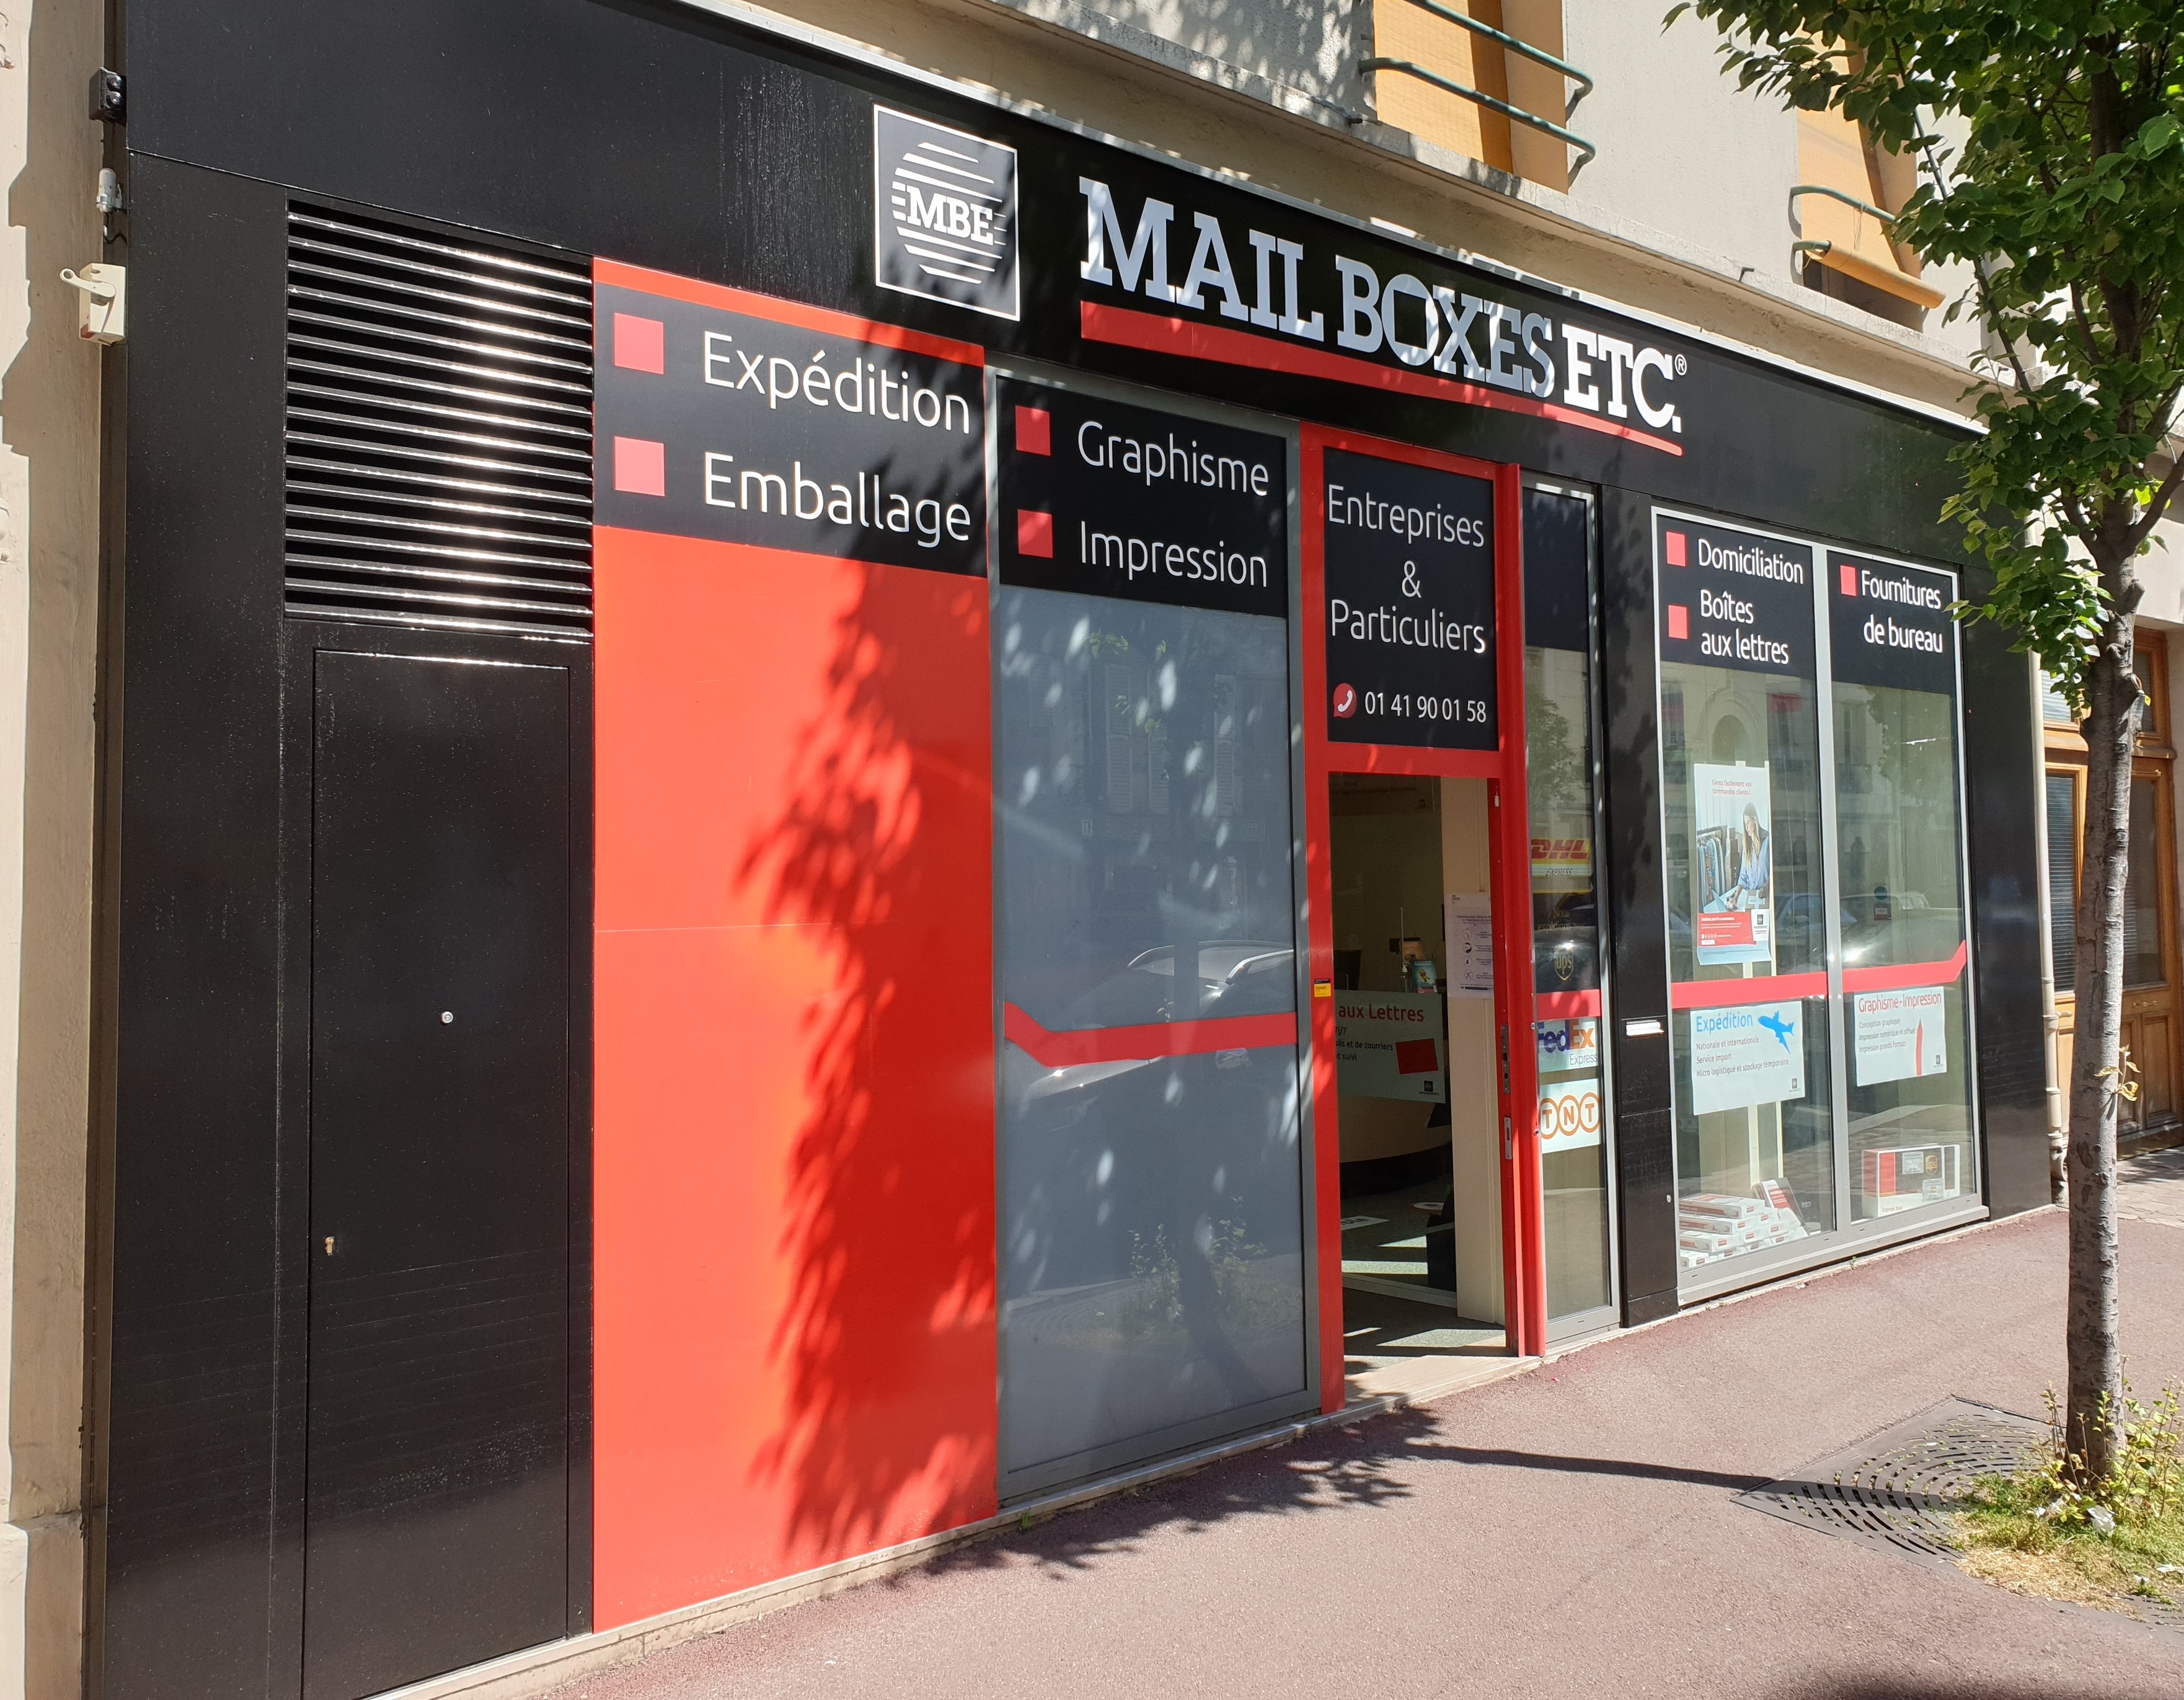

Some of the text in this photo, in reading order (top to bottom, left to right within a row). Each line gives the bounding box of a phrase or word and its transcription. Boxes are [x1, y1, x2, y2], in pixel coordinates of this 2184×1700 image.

[908, 185, 994, 246] MBE
[1079, 176, 1324, 342] MAIL
[1336, 254, 1555, 397] BOXES
[704, 330, 970, 434] Expédition
[1078, 421, 1268, 497] Graphisme
[704, 452, 971, 548] Emballage
[1328, 484, 1485, 547] Entreprises
[1081, 520, 1267, 588] Impression
[1698, 538, 1804, 585] Domiciliation
[1402, 560, 1422, 599] &
[1861, 569, 1942, 610] Fournitures
[1700, 589, 1754, 624] Boîtes
[1331, 599, 1486, 654] Particuliers
[1863, 614, 1943, 654] de bureau
[1701, 629, 1790, 665] aux lettres
[1364, 691, 1487, 724] 01 41 90 01 58
[1531, 839, 1589, 860] DHL
[1545, 868, 1572, 877] EXPRESS
[1556, 954, 1573, 975] ups
[1338, 1003, 1425, 1022] aux Lettres
[1695, 1011, 1754, 1035] Expédition
[1355, 1040, 1363, 1049] de
[1364, 1042, 1394, 1051] courriers
[1569, 1053, 1598, 1066] Express
[1696, 1041, 1720, 1051] Nationale
[1727, 1035, 1759, 1047] Internationale
[1696, 1053, 1732, 1065] Service Import
[1696, 1058, 1790, 1078] Micro logistique et stockage temporaire
[1542, 1102, 1595, 1129] TNT
